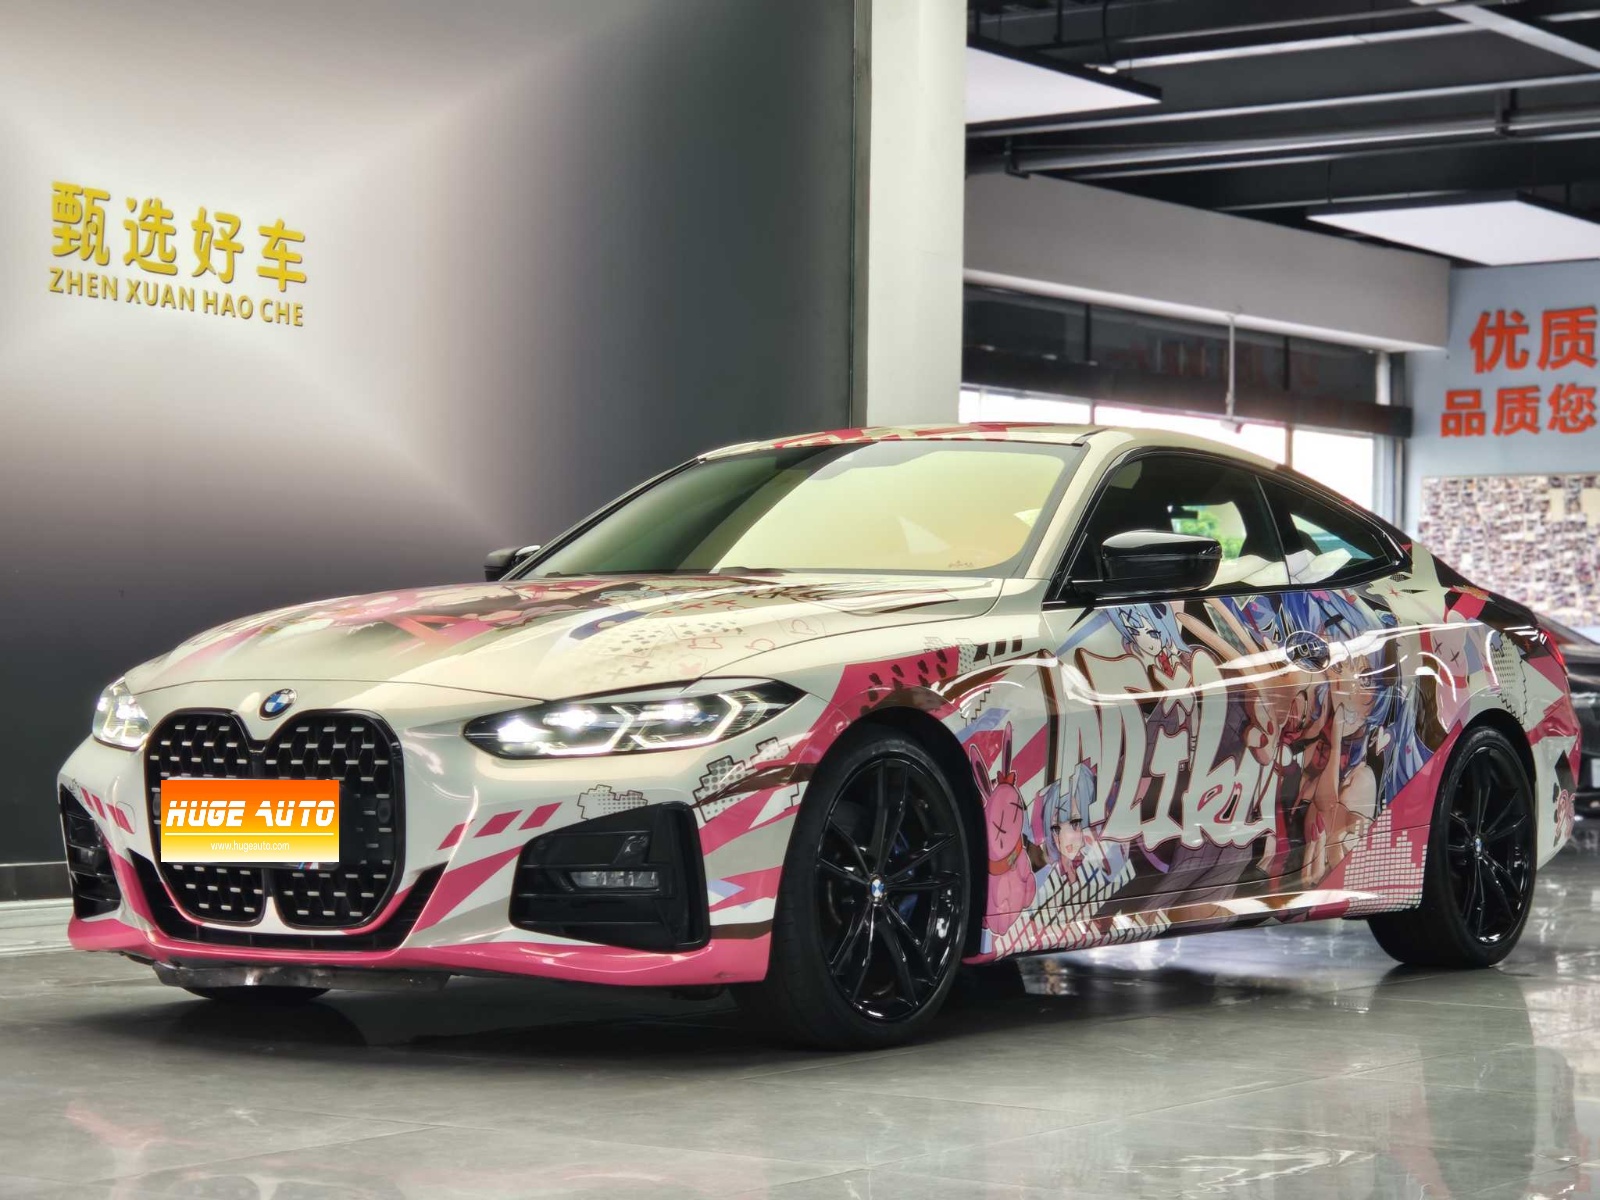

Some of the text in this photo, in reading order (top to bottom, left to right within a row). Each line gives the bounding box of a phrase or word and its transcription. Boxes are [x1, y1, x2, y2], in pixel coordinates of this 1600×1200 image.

[51, 181, 308, 292] 甄选好车
[50, 267, 304, 327] ZHEN XUAN HAO CHE
[1469, 306, 1597, 374] 优质
[1440, 383, 1597, 438] 品质您
